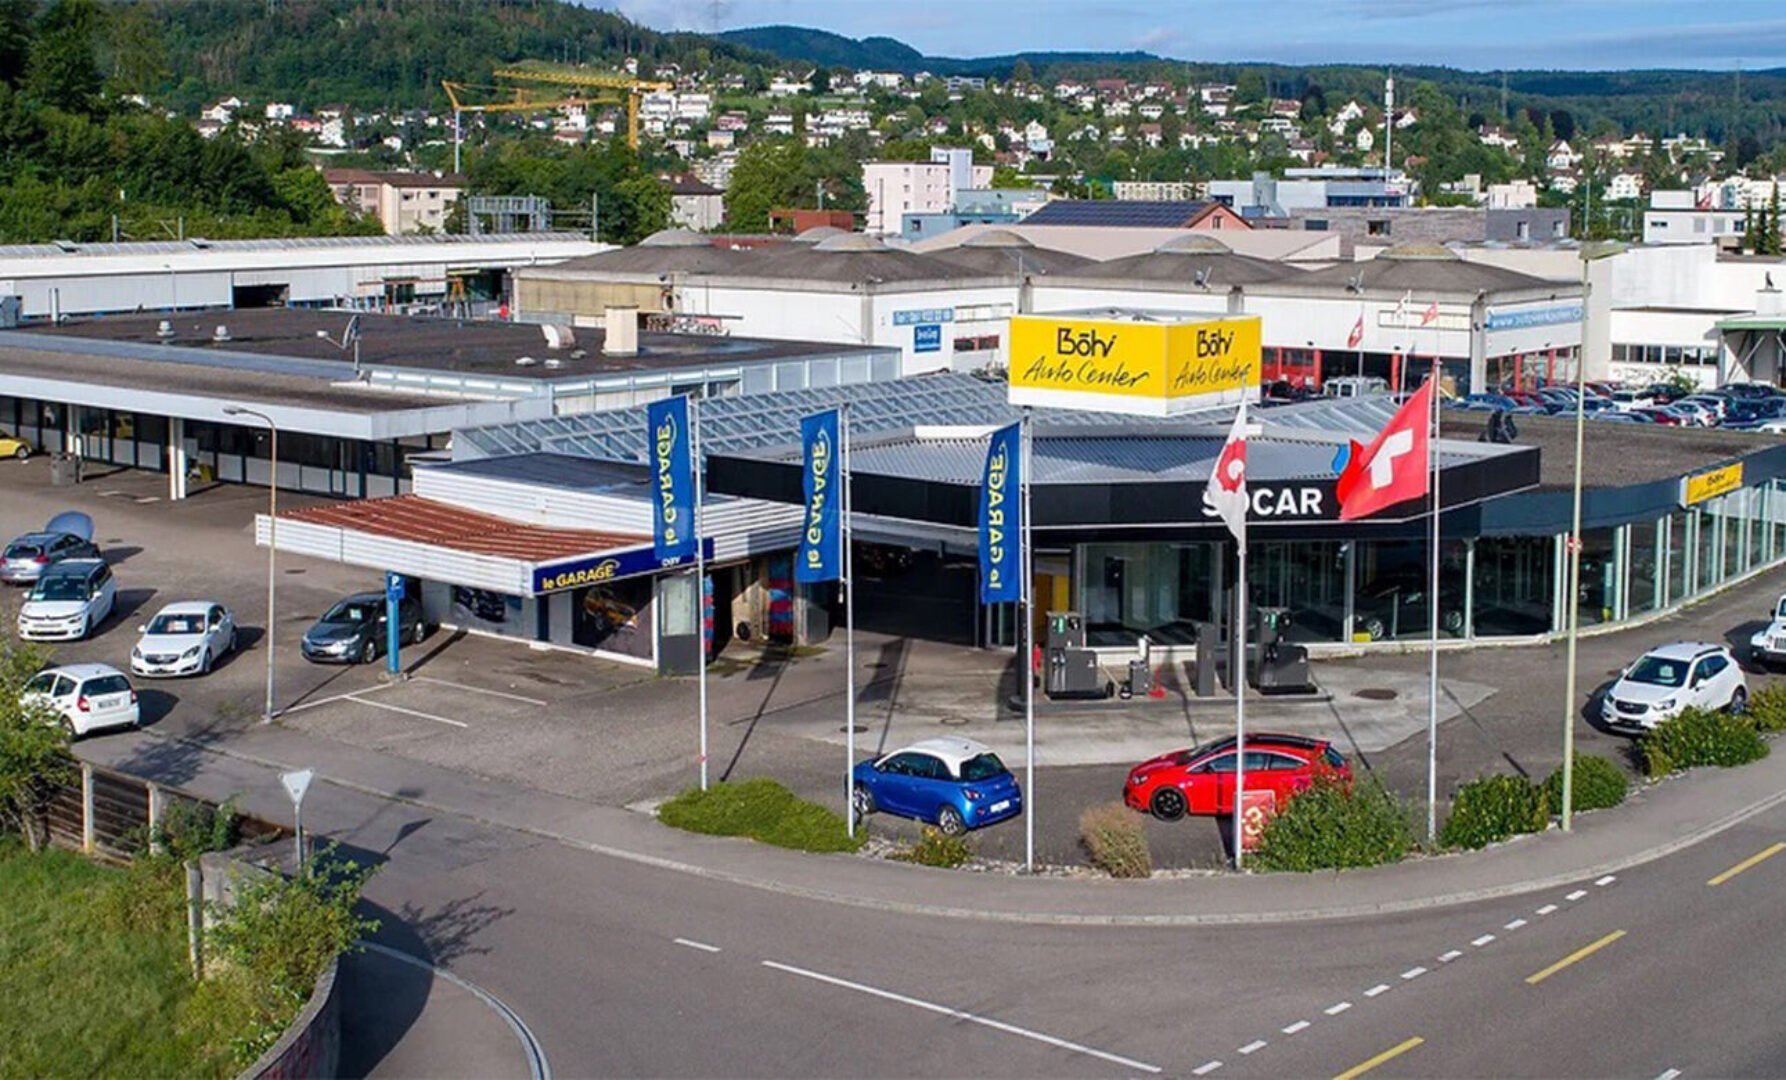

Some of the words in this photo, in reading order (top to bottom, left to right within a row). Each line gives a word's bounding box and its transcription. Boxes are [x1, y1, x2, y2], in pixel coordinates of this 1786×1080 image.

[1023, 356, 1073, 382] Auto
[1076, 361, 1150, 387] Center
[1201, 487, 1323, 517] SCAR
[556, 565, 615, 587] GARAGE
